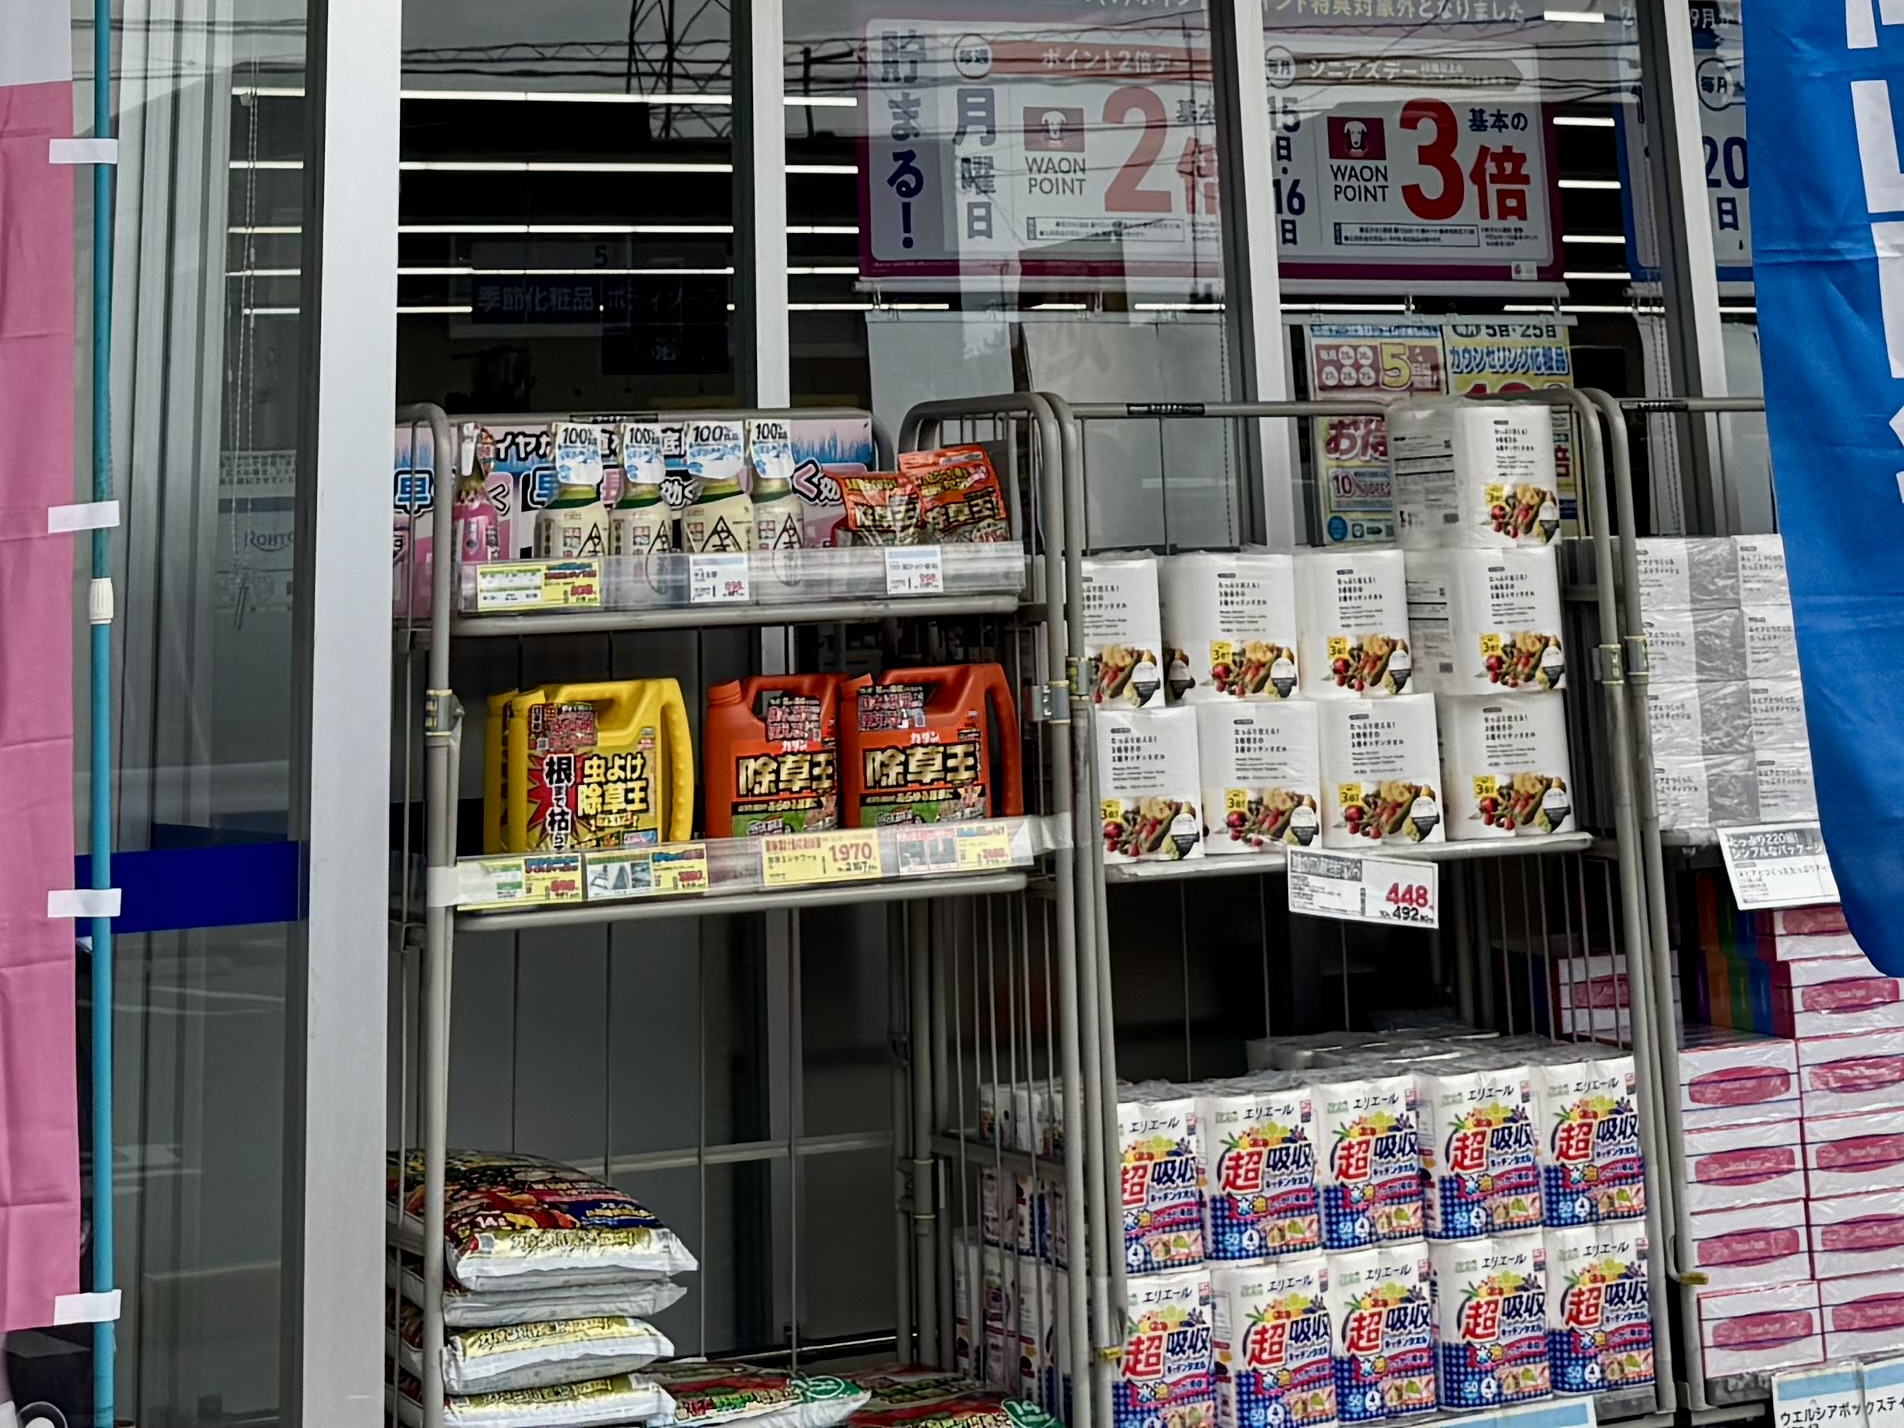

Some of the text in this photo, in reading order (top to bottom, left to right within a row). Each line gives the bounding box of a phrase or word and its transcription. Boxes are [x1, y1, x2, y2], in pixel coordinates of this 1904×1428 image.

[1308, 59, 1418, 81] シニアズデー
[1467, 108, 1529, 134] 基本の
[880, 28, 927, 250] 貯まる!
[953, 87, 998, 240] 月曜日
[1025, 156, 1088, 175] WAON
[1329, 164, 1389, 183] WAON
[1398, 97, 1531, 222] 3倍
[1027, 177, 1088, 196] POINT
[1333, 185, 1390, 203] POINT
[477, 285, 594, 313] 季節化粧品
[583, 753, 646, 782] 虫よけ
[738, 751, 836, 796] 除草王
[864, 743, 979, 790] 除草王
[576, 780, 649, 817] 除草王
[828, 842, 873, 862] 1970
[1385, 881, 1429, 908] 448
[1467, 1085, 1515, 1101] エリエール
[1573, 1077, 1619, 1093] エリエール
[1243, 1104, 1294, 1120] エリエール
[1353, 1093, 1399, 1110] エリエール
[1129, 1116, 1180, 1133] エリエール
[1555, 1114, 1638, 1163] 超吸収
[1335, 1132, 1418, 1182] 超吸収
[1449, 1122, 1534, 1173] 超吸収
[1221, 1141, 1314, 1192] 超吸収
[1246, 1312, 1331, 1366] 超吸収
[1122, 1327, 1211, 1380] 超吸収
